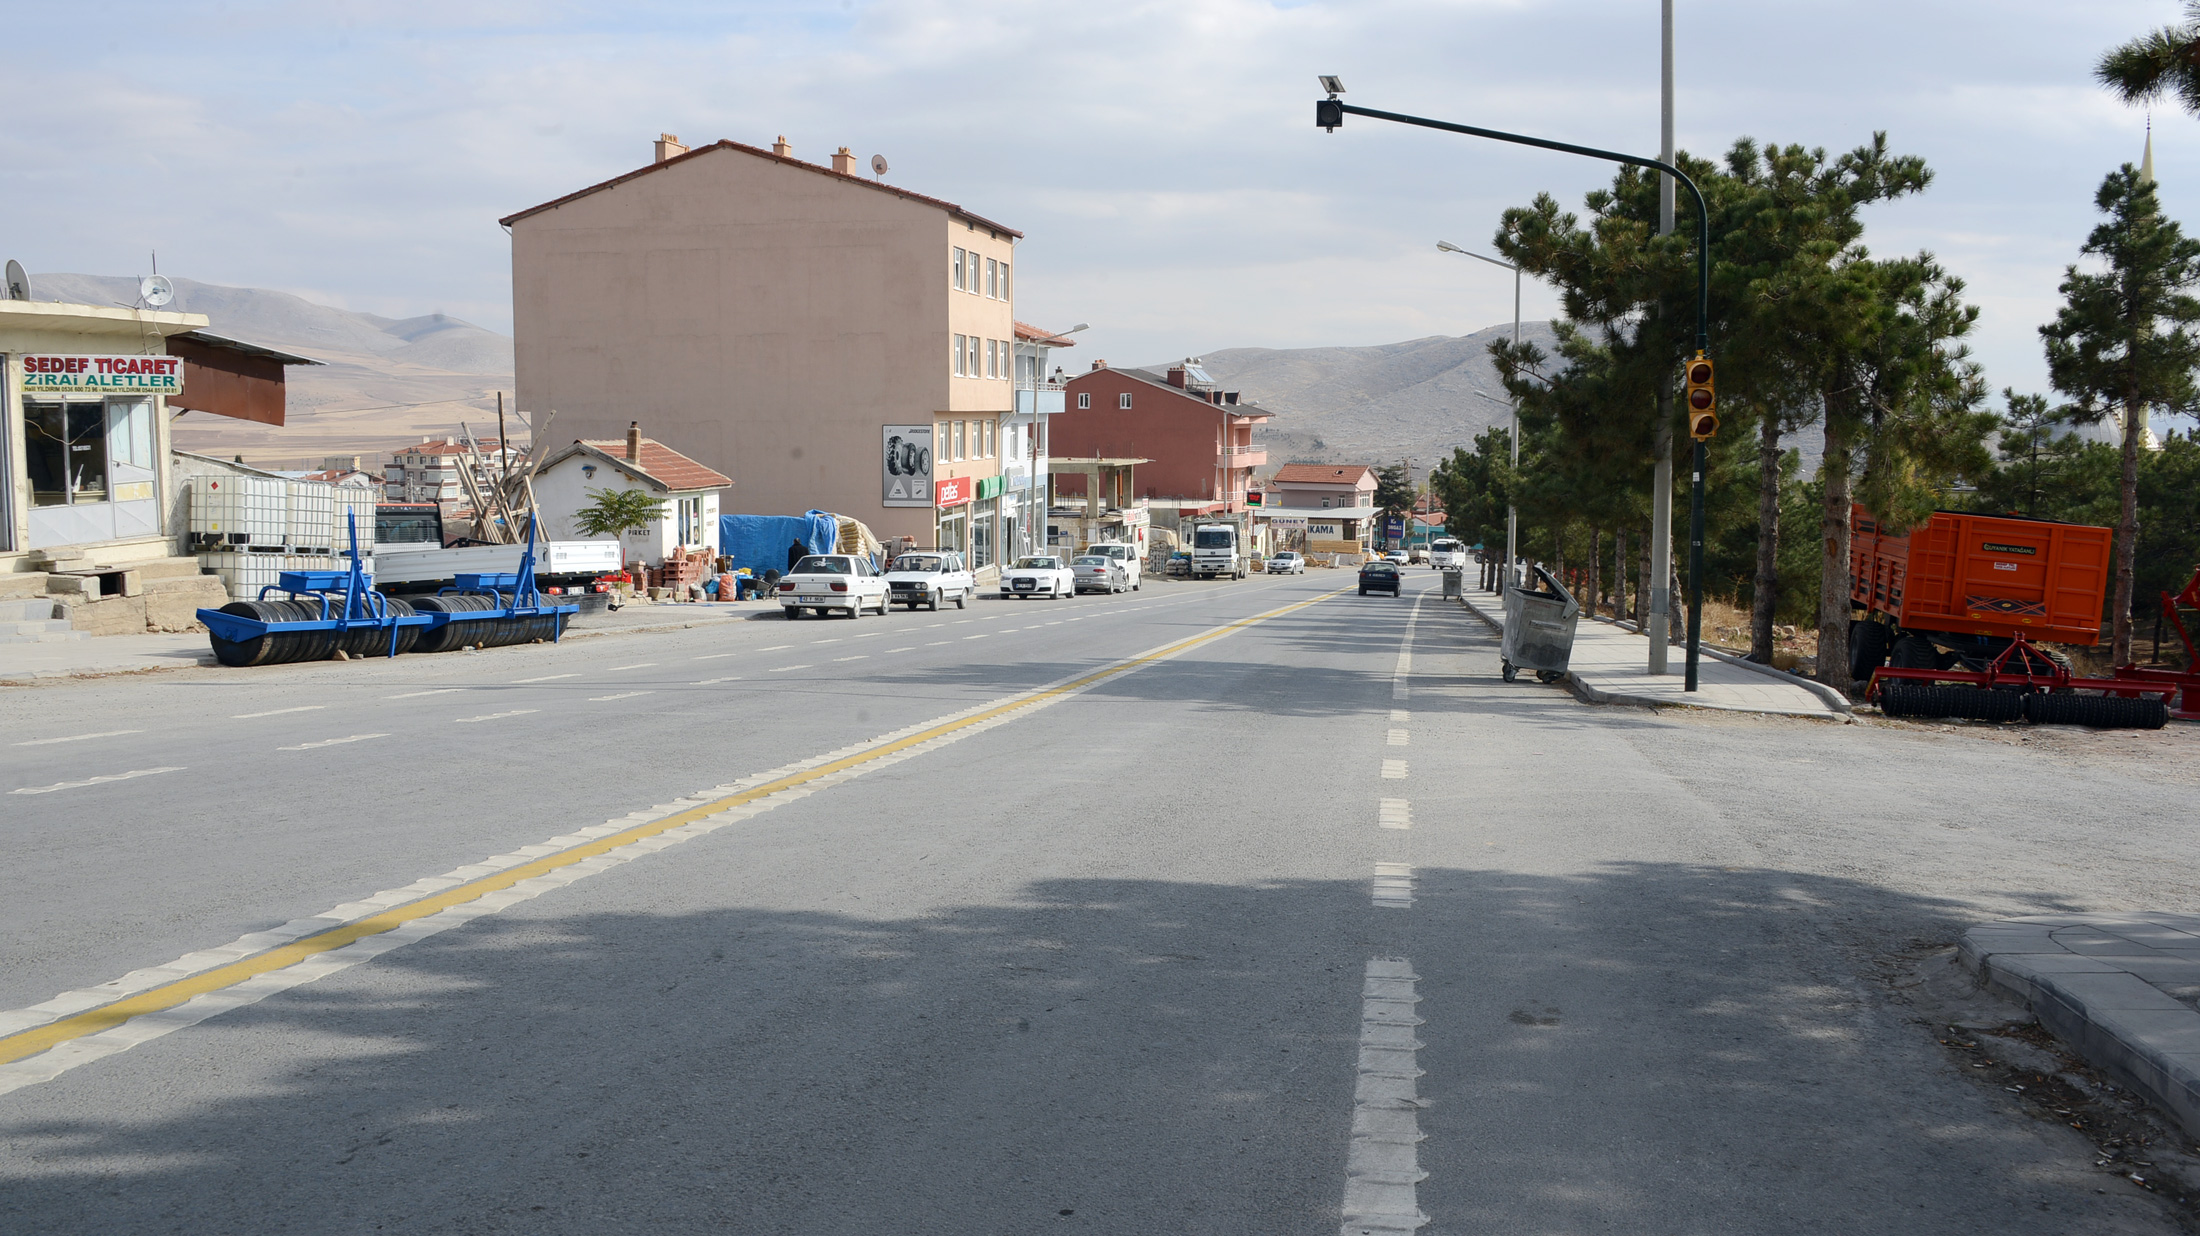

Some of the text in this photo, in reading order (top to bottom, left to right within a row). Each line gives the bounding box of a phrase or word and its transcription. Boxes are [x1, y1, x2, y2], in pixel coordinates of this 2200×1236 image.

[24, 357, 89, 373] SEDEF
[85, 374, 176, 387] ALETLER
[1307, 525, 1334, 534] IKAMA
